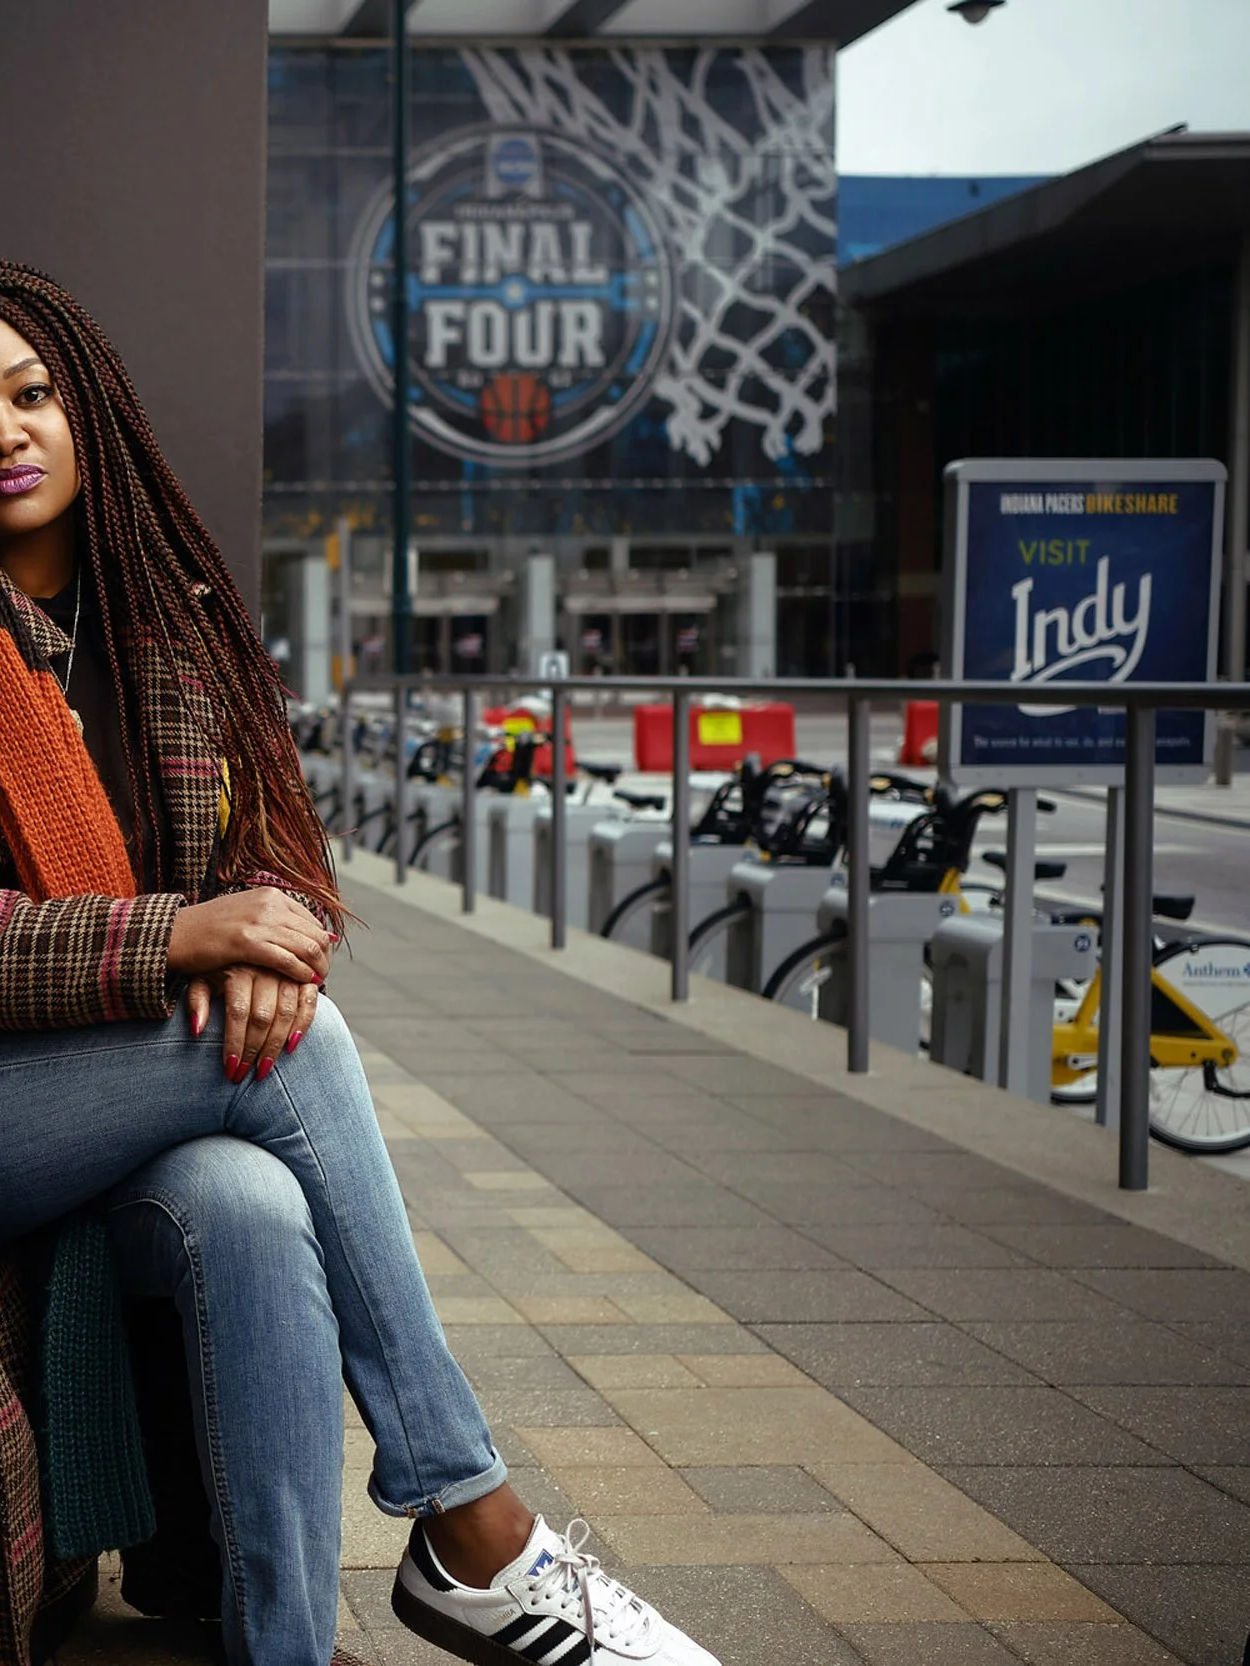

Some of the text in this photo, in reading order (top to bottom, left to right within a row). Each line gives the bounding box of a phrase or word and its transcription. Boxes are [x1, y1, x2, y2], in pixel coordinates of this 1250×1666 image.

[419, 220, 609, 284] FINAL
[424, 300, 606, 368] FOUR
[1045, 493, 1085, 514] PACERS
[1018, 540, 1091, 565] VISIT
[1010, 555, 1152, 716] Indy
[1182, 961, 1241, 978] Anthem
